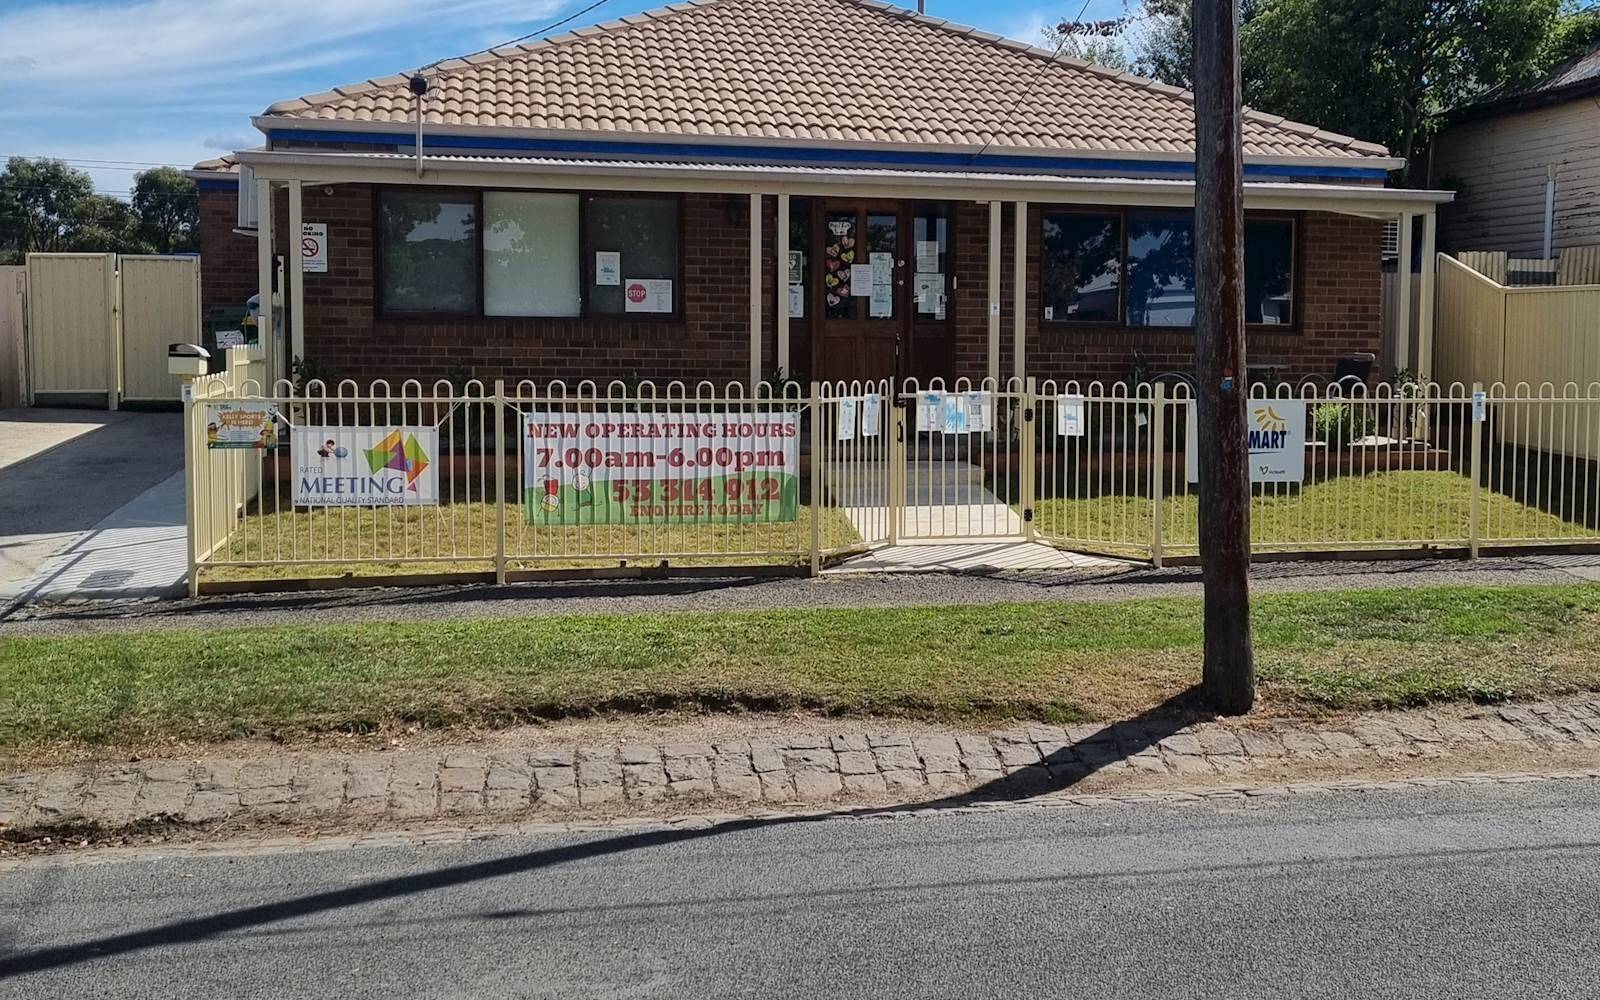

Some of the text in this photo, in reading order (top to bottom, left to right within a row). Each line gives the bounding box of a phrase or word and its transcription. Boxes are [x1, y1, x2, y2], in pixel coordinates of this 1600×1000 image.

[527, 423, 796, 438] NEW OPERATING HOURS
[1248, 430, 1287, 449] MART
[536, 447, 785, 472] 7.00am-6.00pm
[299, 466, 324, 474] RATED
[299, 476, 404, 494] MEETING
[612, 478, 779, 503] 53 314 912
[336, 497, 366, 505] QUALITY
[629, 504, 764, 517] ENQUIRE TODAY
